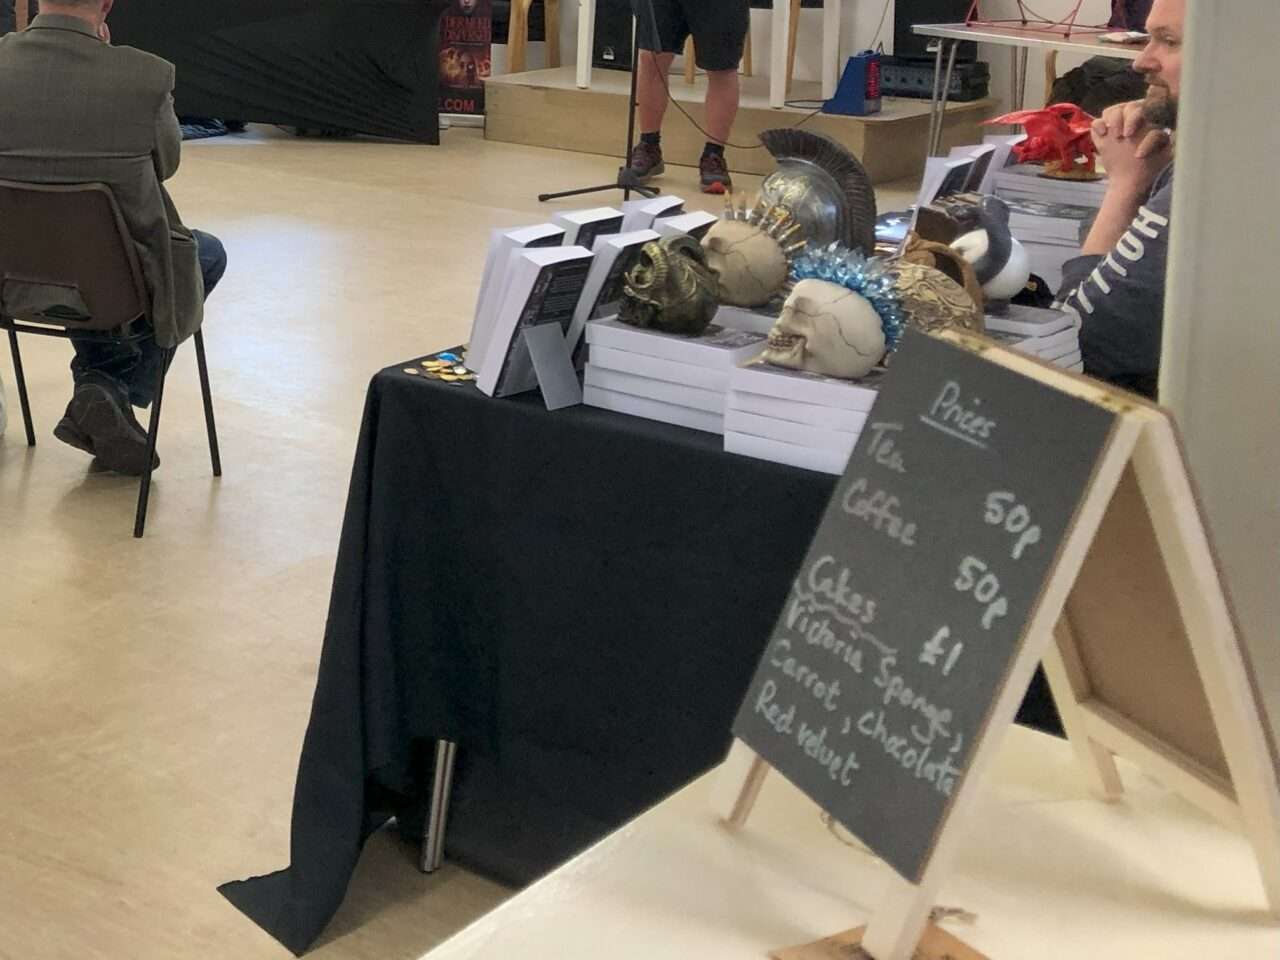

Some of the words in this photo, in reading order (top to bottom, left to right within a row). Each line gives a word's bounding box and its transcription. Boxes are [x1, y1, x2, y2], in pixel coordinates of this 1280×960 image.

[930, 380, 997, 440] Prices
[861, 421, 907, 473] Tea
[984, 490, 1042, 560] 50p
[842, 477, 917, 545] Coffee
[954, 555, 1008, 630] 50p
[808, 555, 877, 624] Cakes
[919, 624, 964, 677] £1
[753, 679, 793, 735] Red
